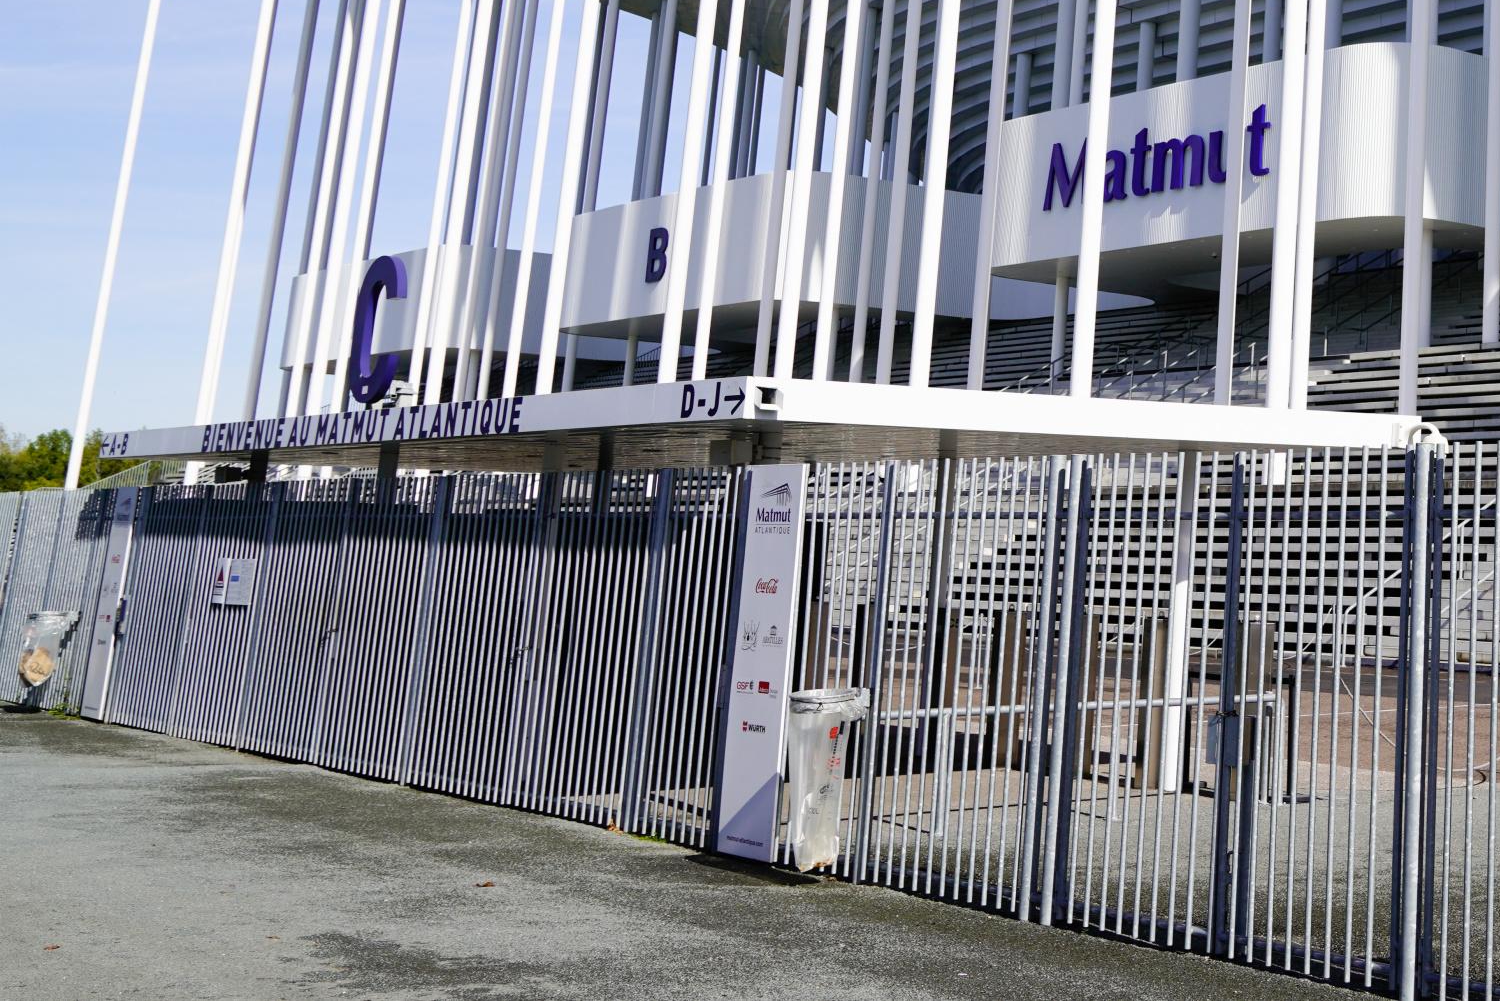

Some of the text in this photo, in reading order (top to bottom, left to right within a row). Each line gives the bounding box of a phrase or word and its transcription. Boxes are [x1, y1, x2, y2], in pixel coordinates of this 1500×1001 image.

[1043, 103, 1272, 212] Matmut
[645, 227, 669, 284] B
[350, 255, 408, 404] C
[201, 396, 524, 452] BIENVENUE AU MATMUT ATLANTIQUE
[754, 526, 791, 535] ATLANTIQUE
[755, 507, 791, 522] Matmut
